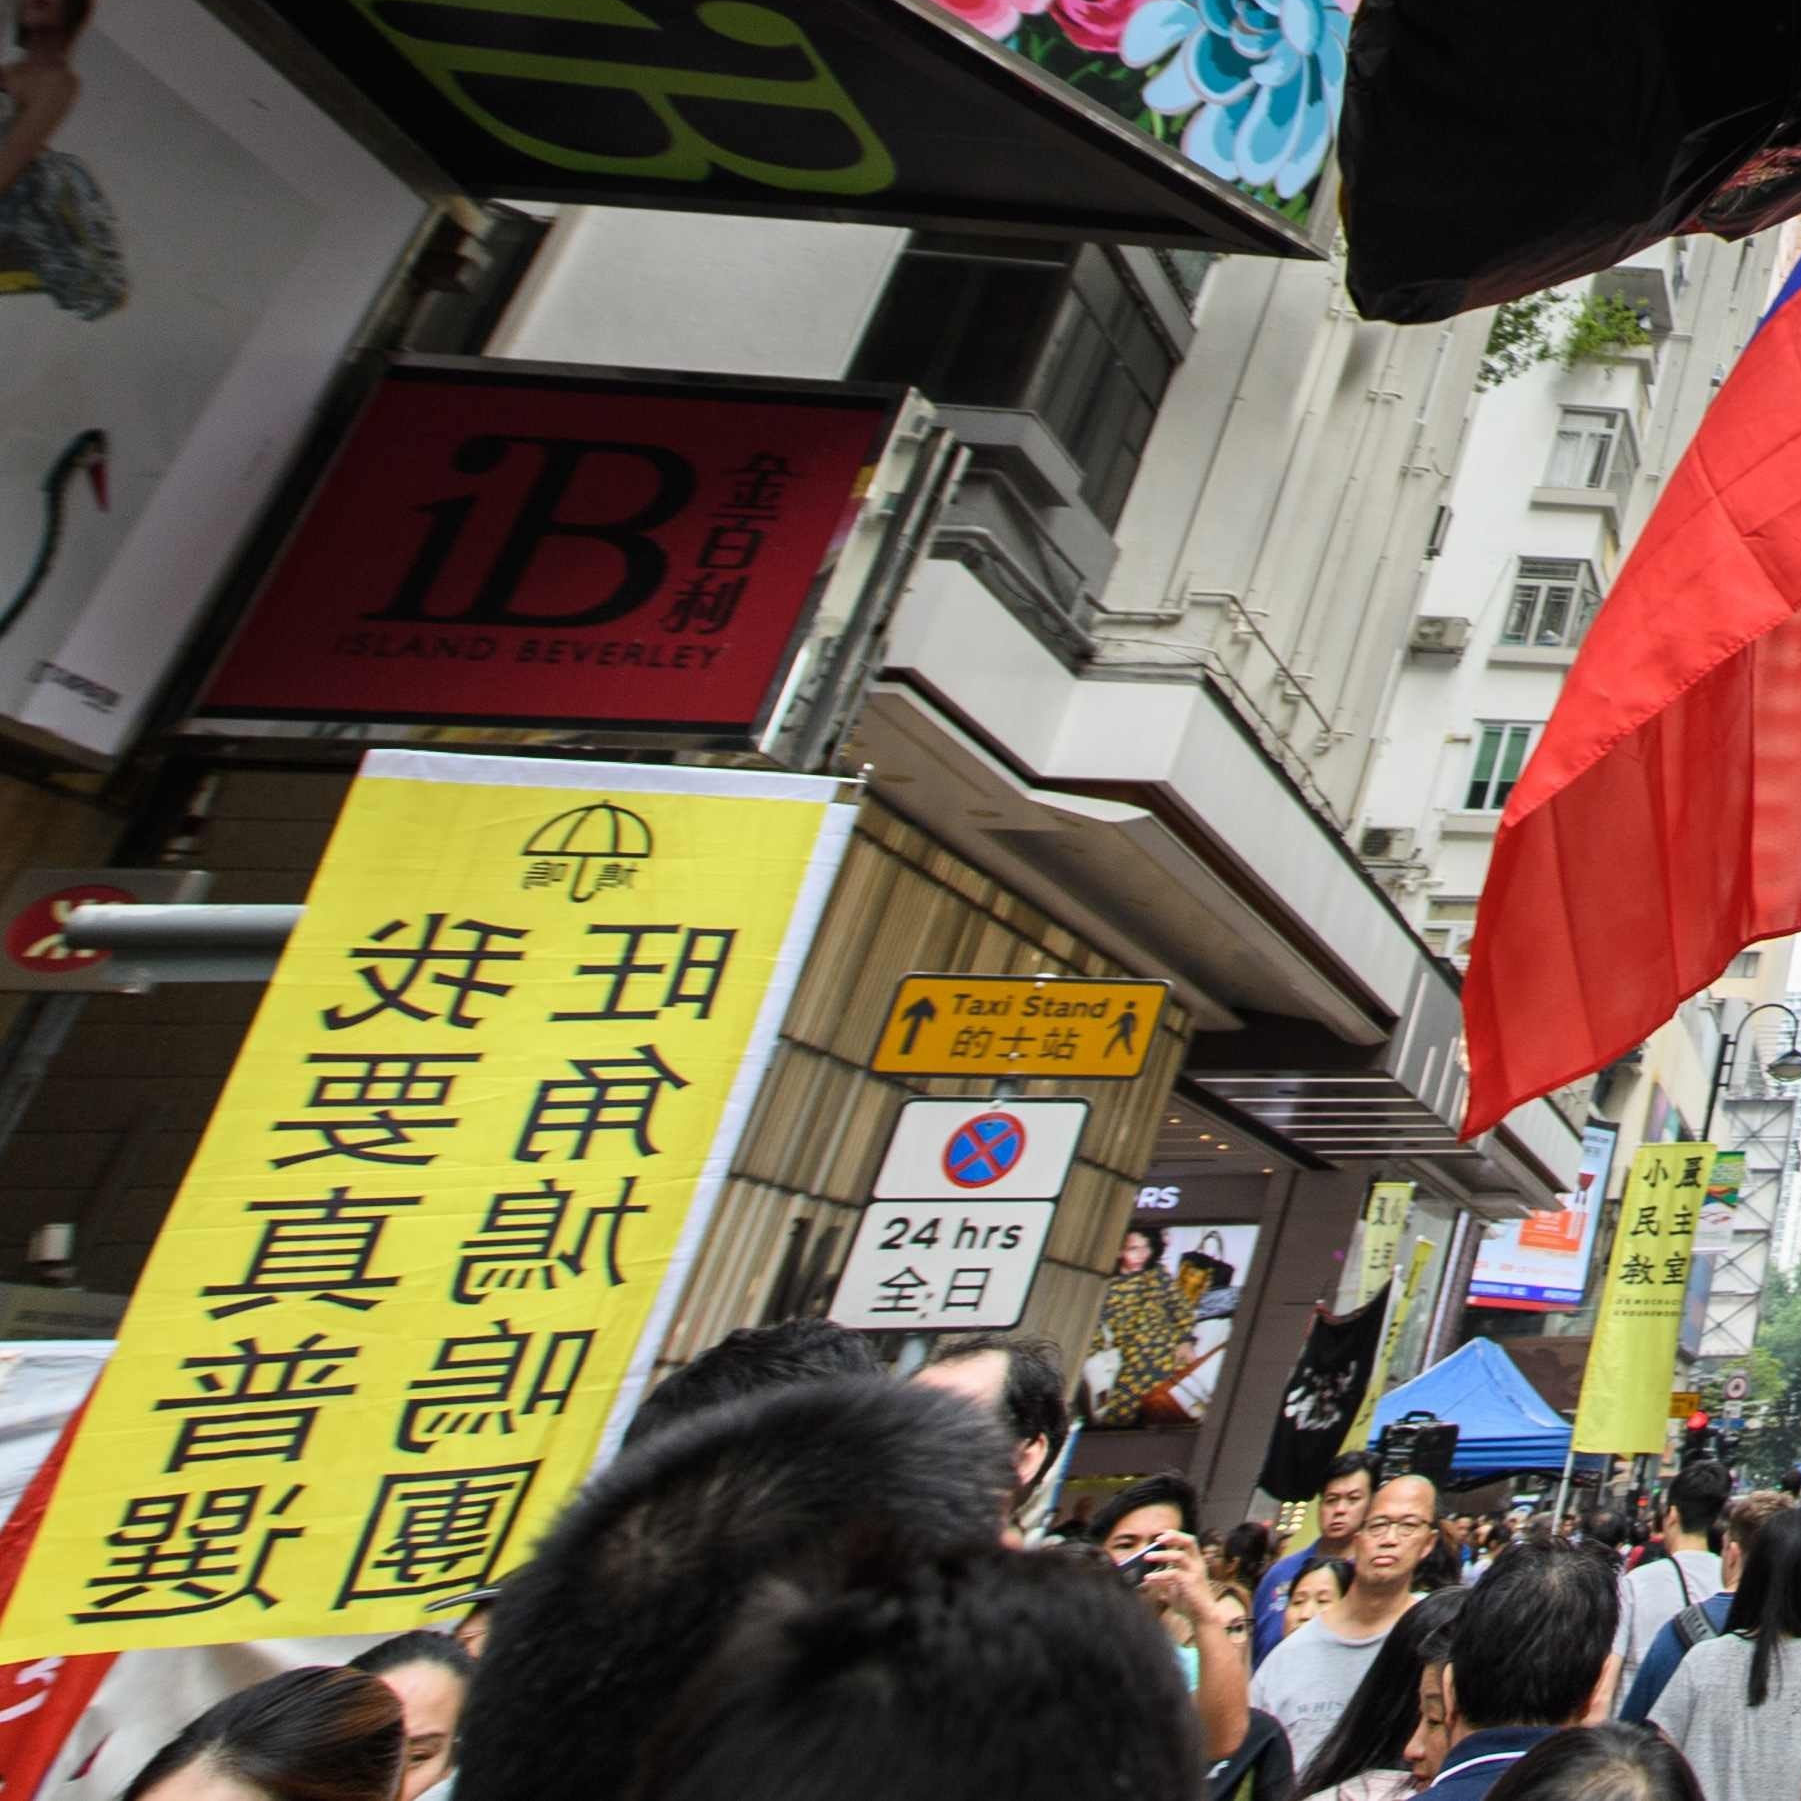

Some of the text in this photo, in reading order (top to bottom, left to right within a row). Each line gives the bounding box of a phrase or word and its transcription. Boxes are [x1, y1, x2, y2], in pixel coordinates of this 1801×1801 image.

[358, 435, 698, 629] iB
[659, 451, 792, 636] 金百利
[336, 633, 726, 671] ISLAND BEVERLEY
[951, 993, 1109, 1021] Taxi Stand
[949, 1025, 1082, 1061] 的士站
[877, 1217, 1024, 1251] 24 hrs
[869, 1265, 995, 1315] 全日
